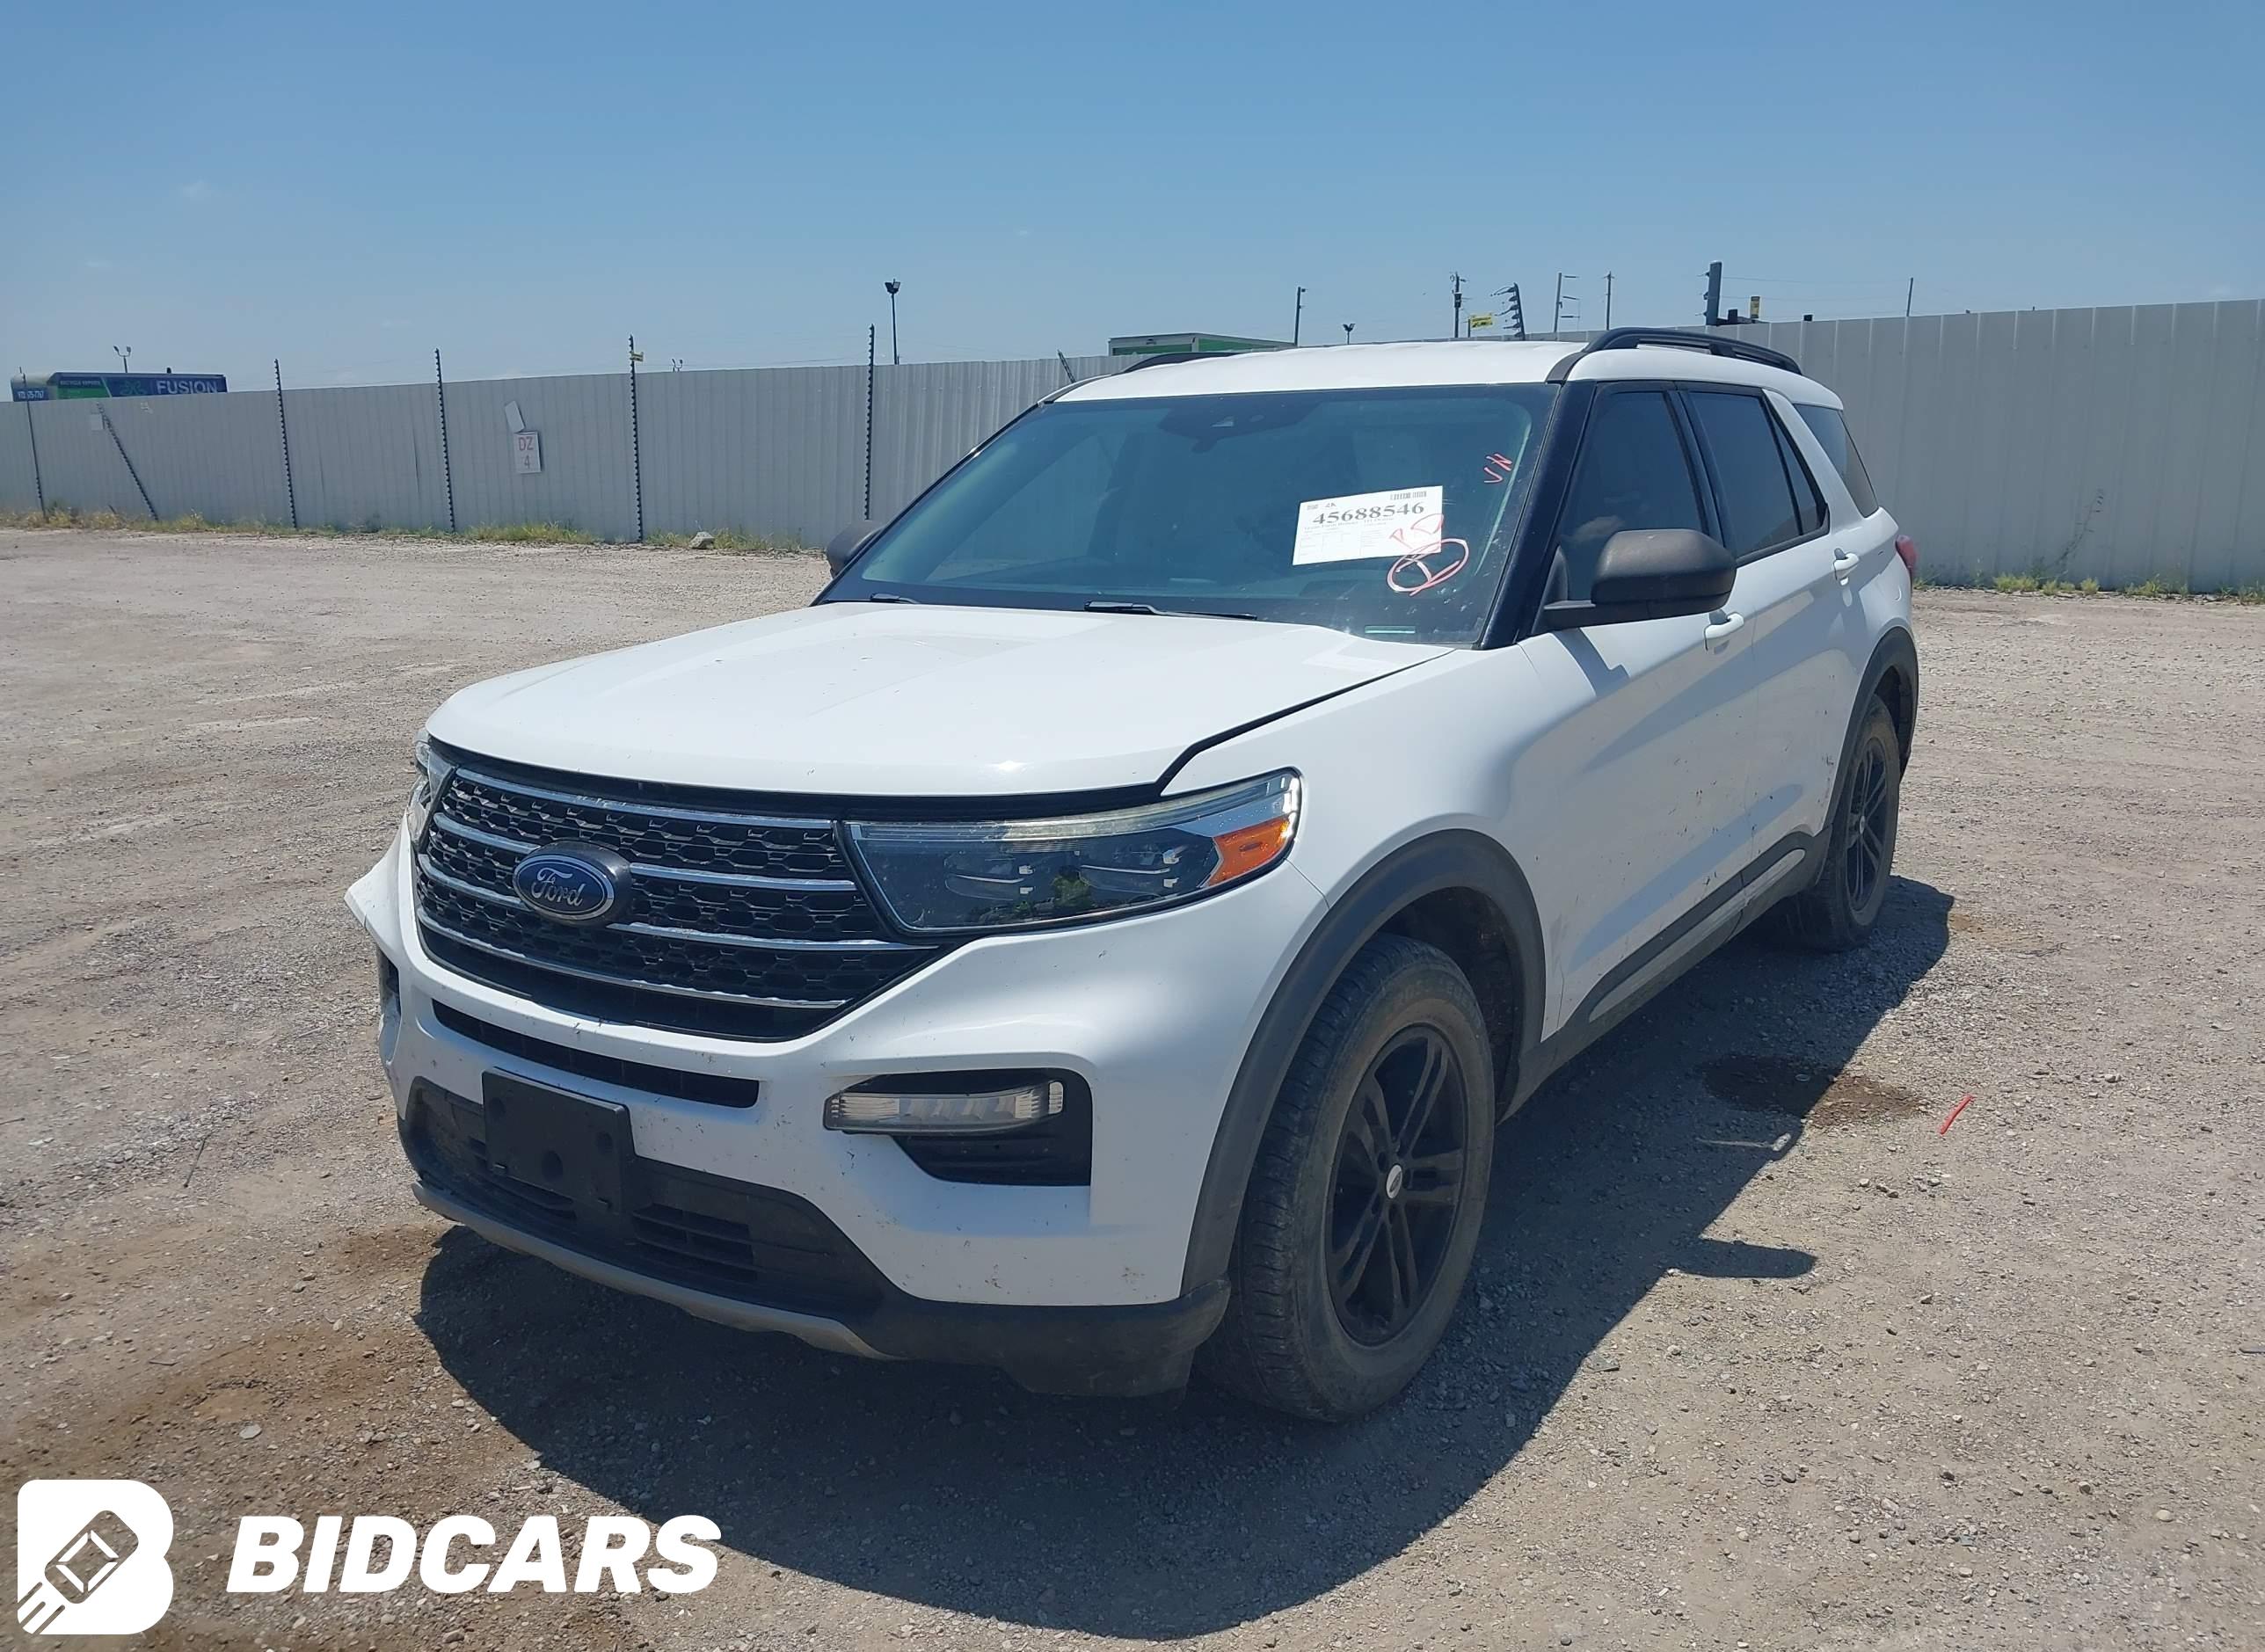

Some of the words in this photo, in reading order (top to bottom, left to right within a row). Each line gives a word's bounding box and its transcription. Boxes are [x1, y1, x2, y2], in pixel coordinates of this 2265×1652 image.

[157, 379, 218, 395] FUSION
[1313, 500, 1424, 525] 45688546
[531, 867, 586, 906] Ford
